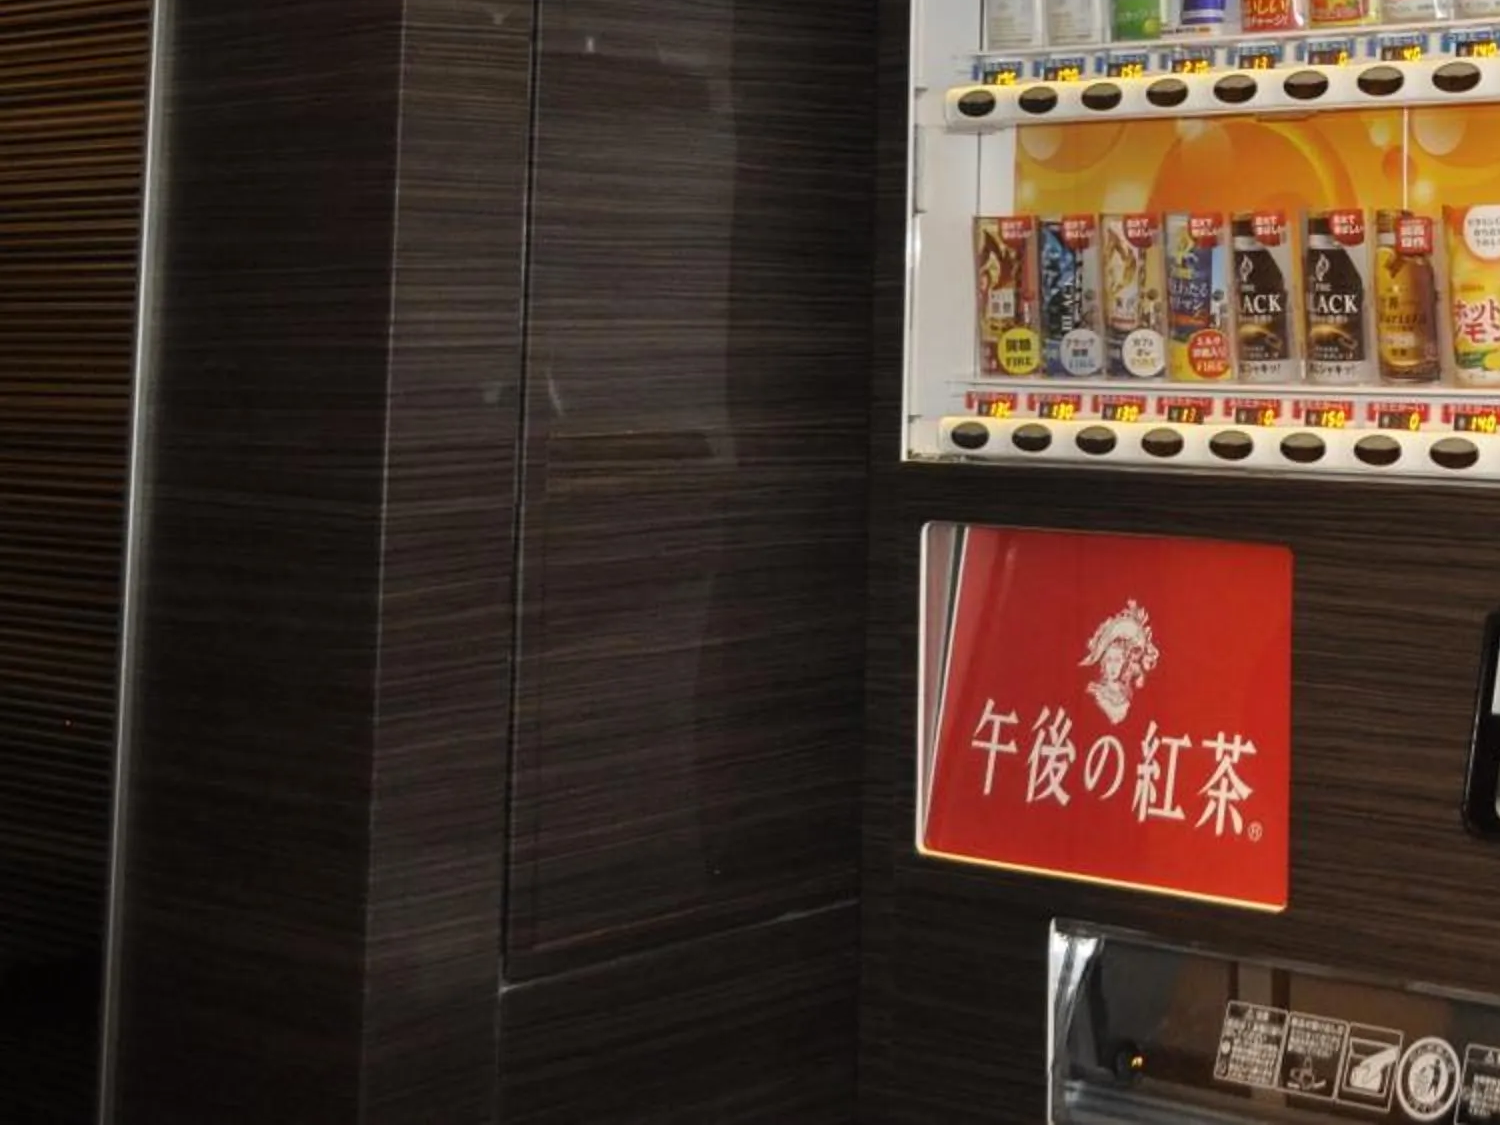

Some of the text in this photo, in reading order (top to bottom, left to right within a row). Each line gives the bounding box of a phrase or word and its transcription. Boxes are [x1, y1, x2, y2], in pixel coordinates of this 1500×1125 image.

[1243, 295, 1282, 314] ACK
[1322, 410, 1345, 427] 150
[1470, 416, 1497, 433] 140
[971, 698, 1257, 837] 午後の紅茶
